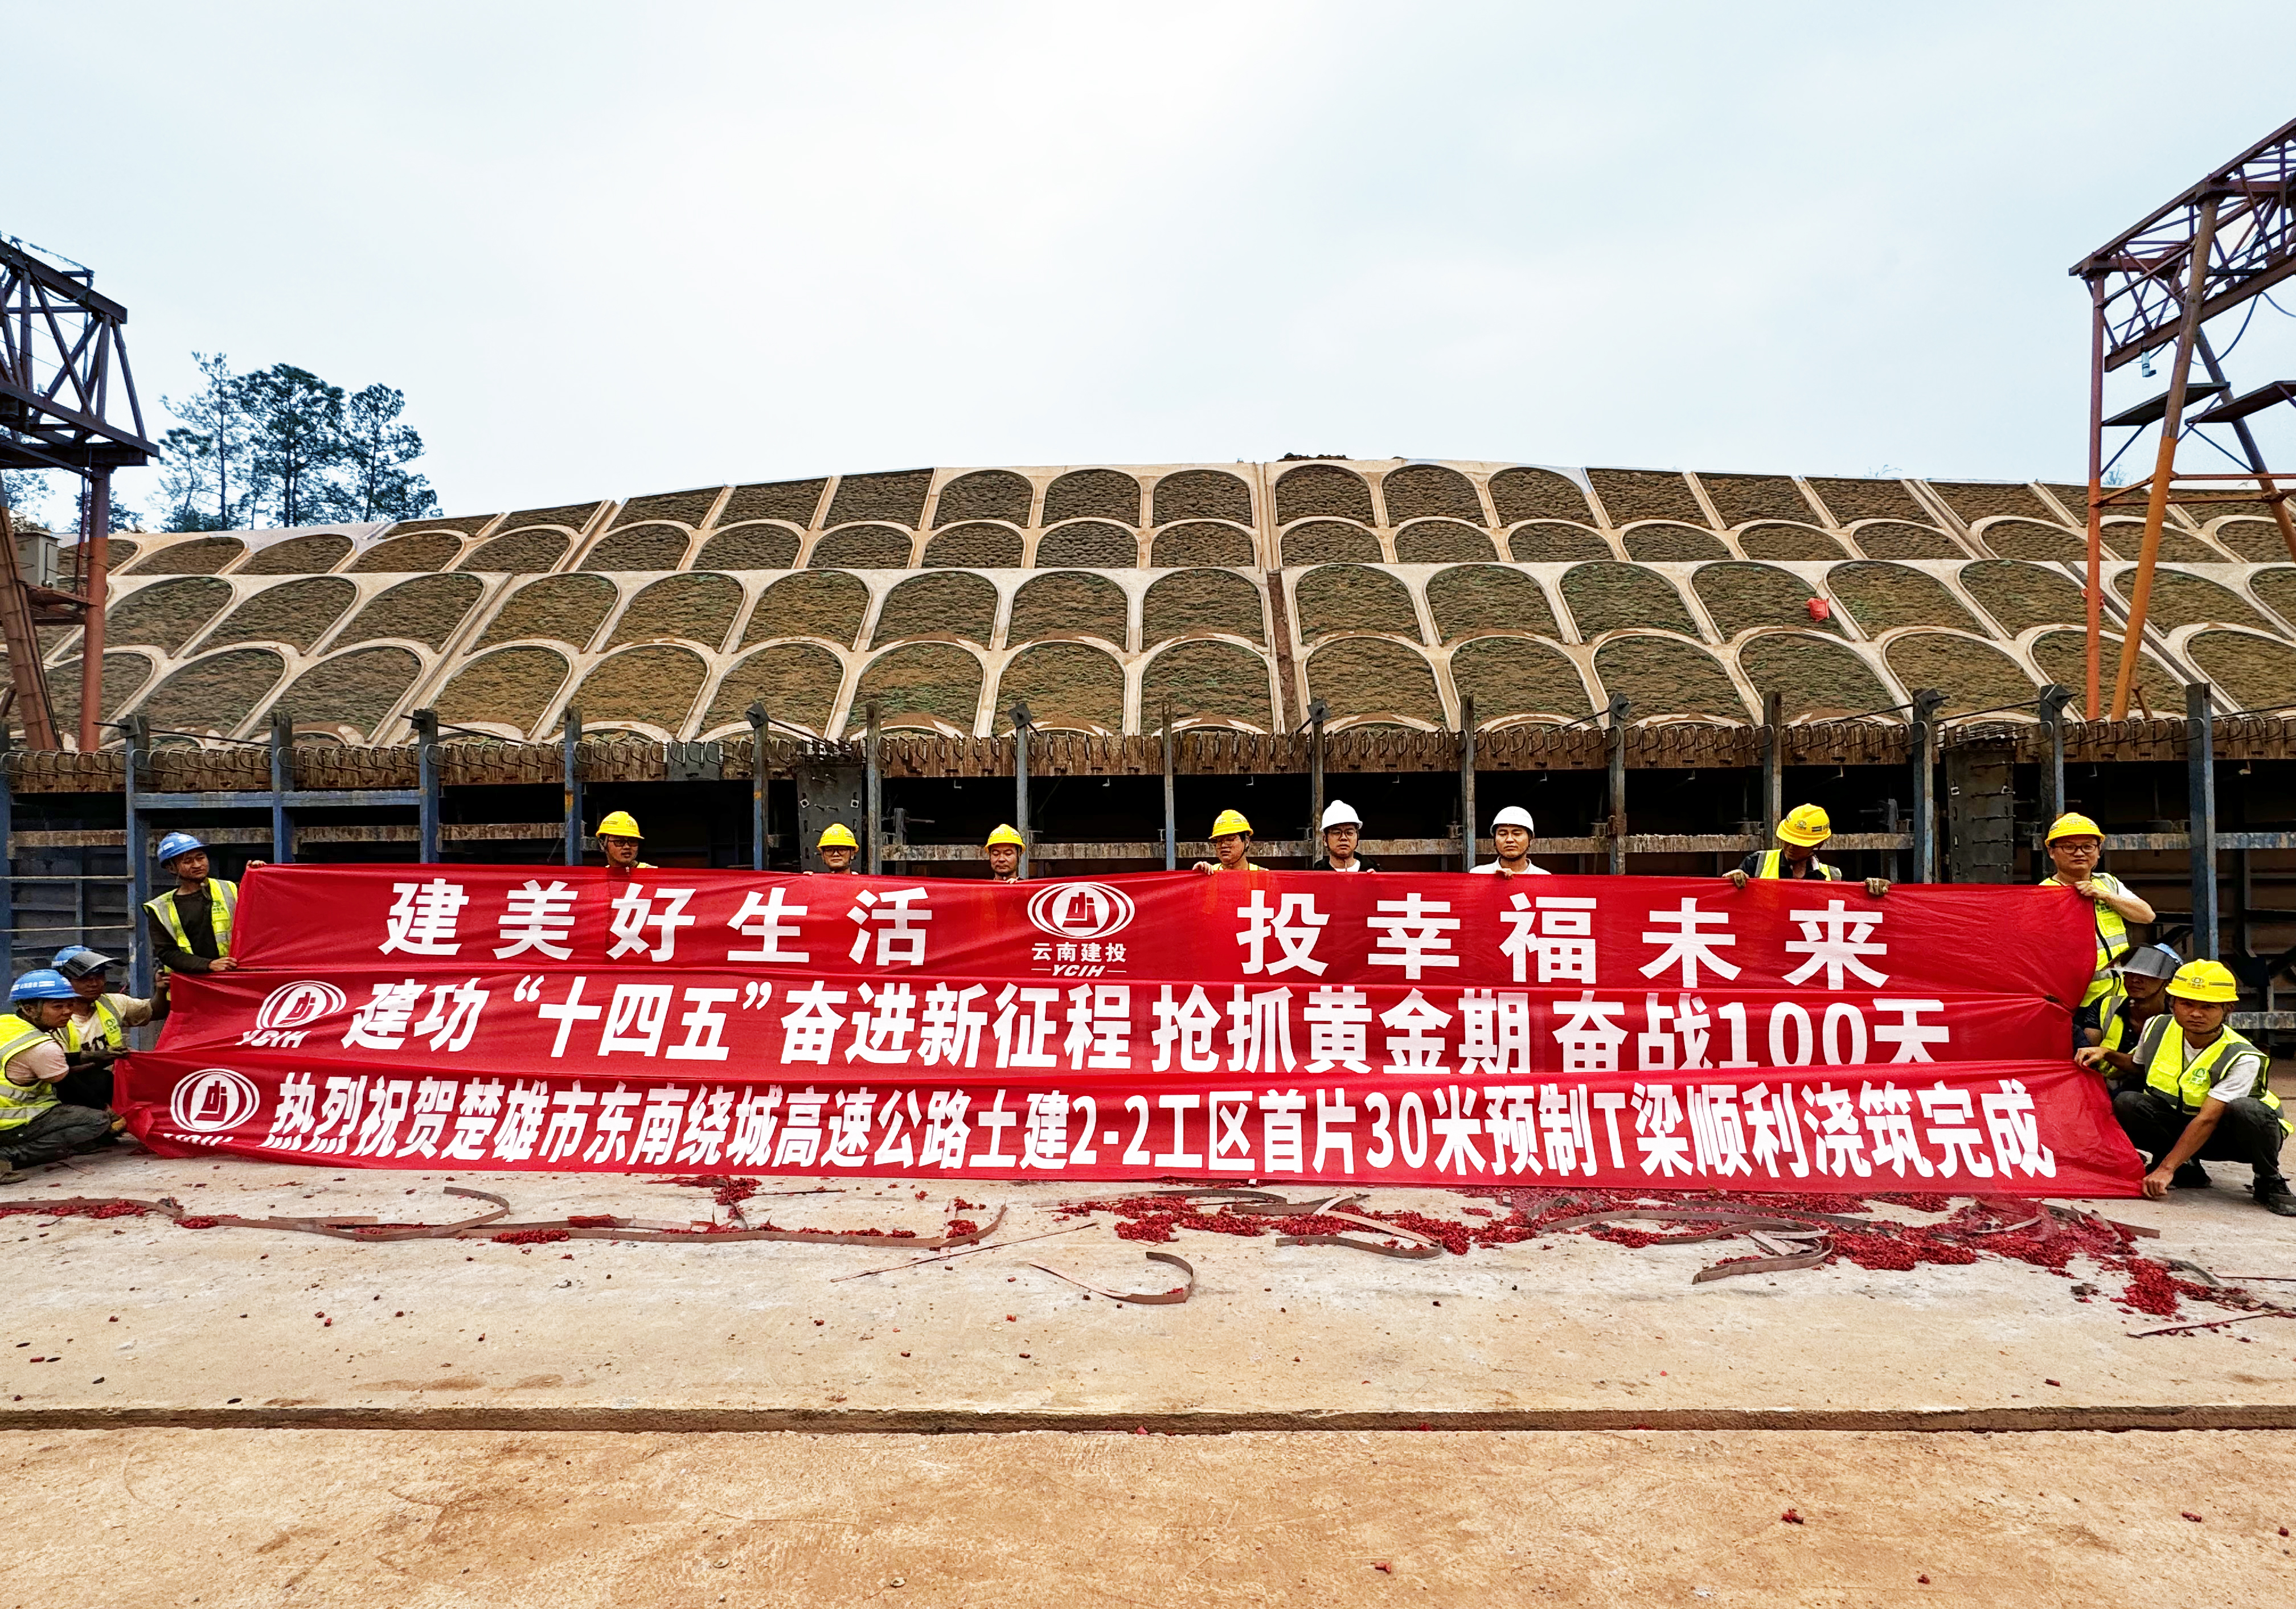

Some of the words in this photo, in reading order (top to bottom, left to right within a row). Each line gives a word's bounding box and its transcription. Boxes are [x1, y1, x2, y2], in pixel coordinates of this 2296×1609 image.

[378, 877, 932, 966] 建美好生活
[1236, 889, 1889, 990] 投幸福未来
[1031, 942, 1126, 962] 云南建投
[1052, 964, 1106, 976] YCIH
